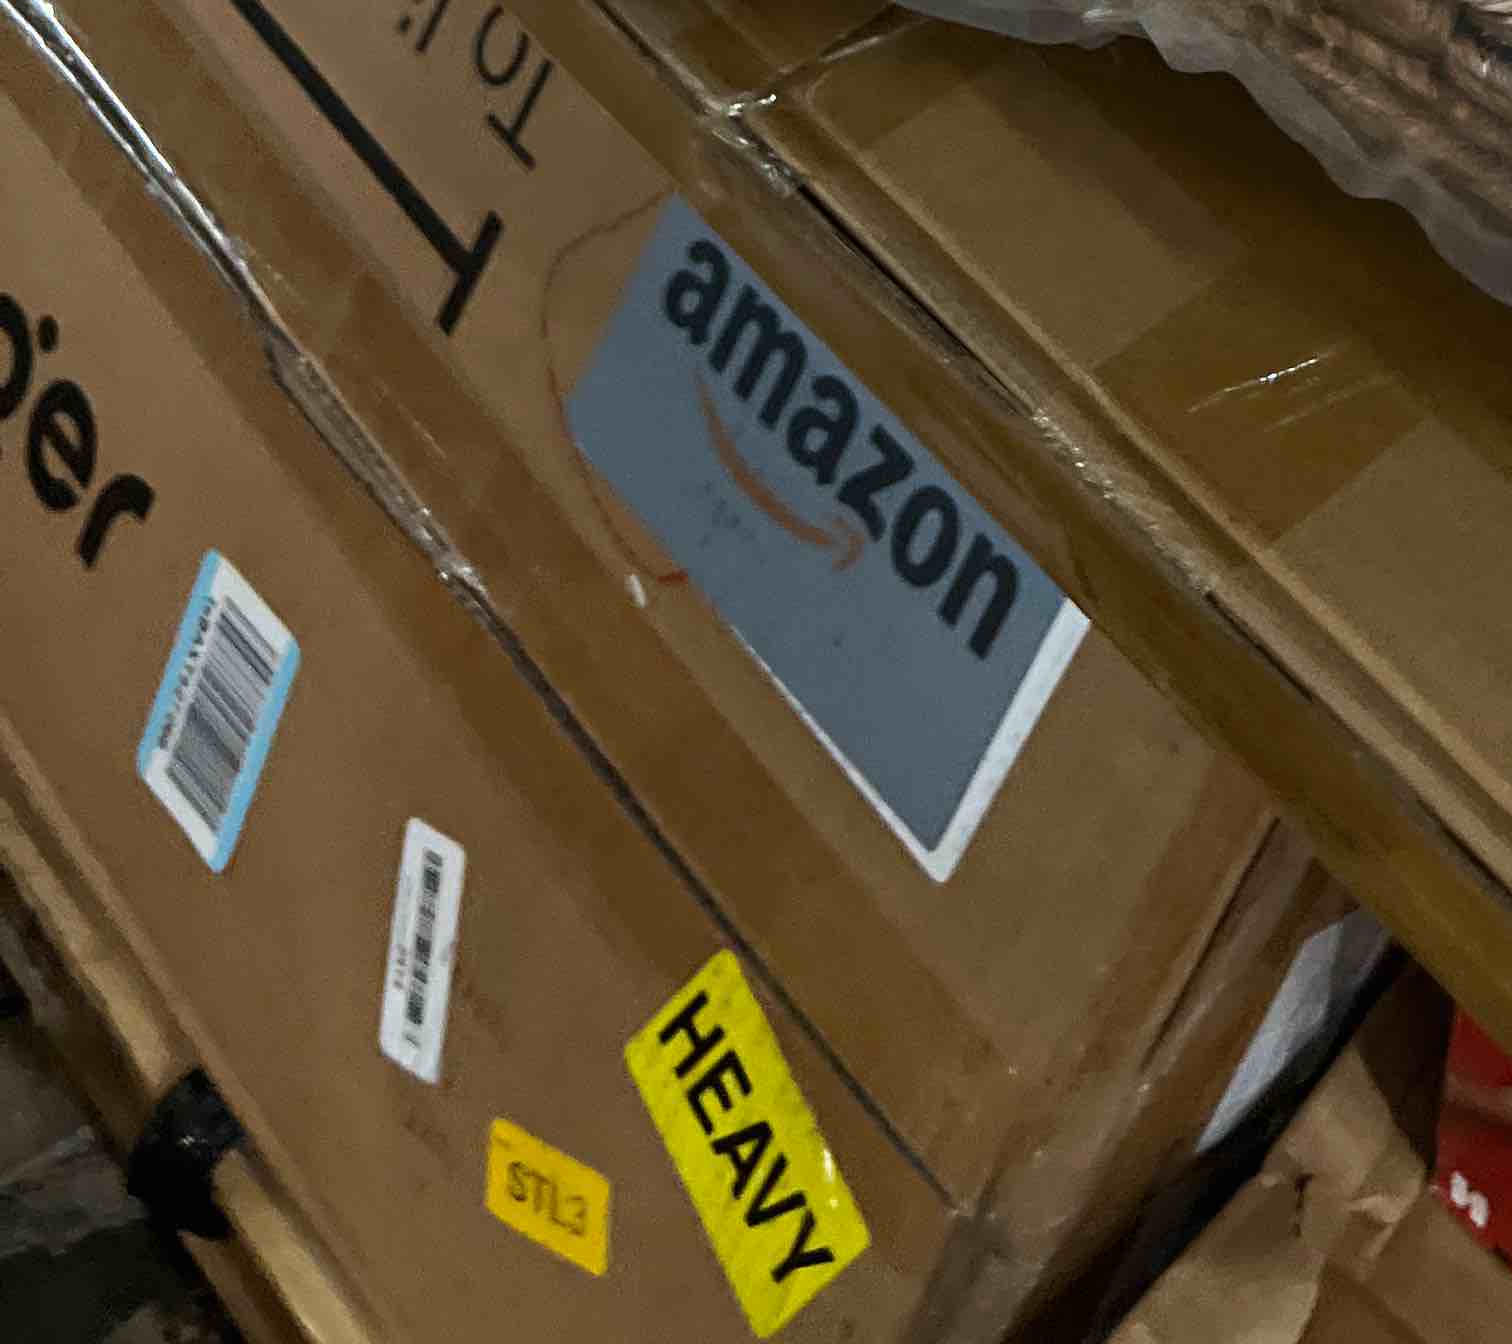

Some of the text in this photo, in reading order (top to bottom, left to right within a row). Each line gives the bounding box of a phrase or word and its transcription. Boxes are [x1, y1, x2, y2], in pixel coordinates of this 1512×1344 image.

[469, 5, 557, 172] To
[665, 237, 1022, 662] amazon
[504, 1158, 590, 1238] STL3
[659, 990, 837, 1288] HEAVY
